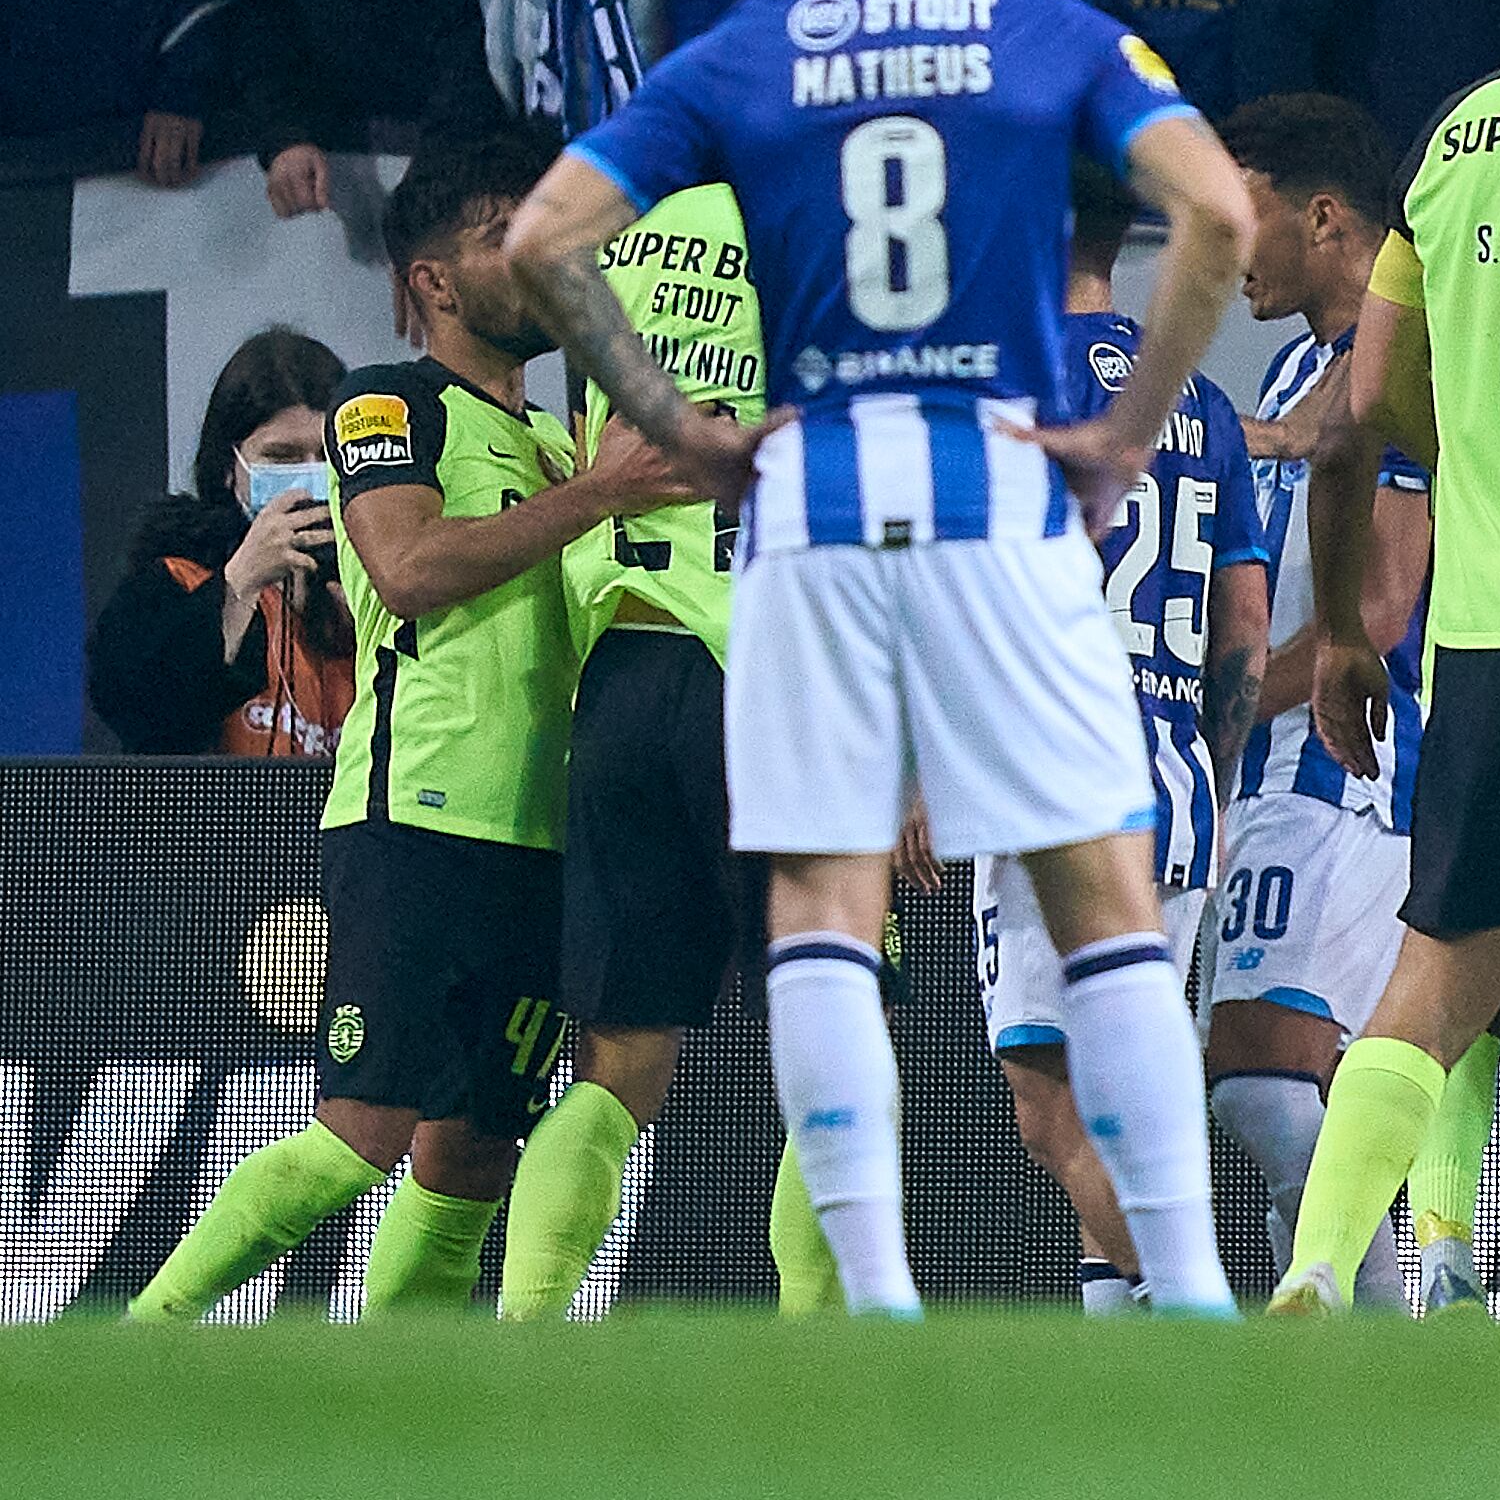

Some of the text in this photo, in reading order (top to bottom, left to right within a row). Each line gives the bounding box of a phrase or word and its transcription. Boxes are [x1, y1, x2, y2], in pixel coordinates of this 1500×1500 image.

[792, 42, 995, 107] MATHEUS
[840, 114, 951, 332] 8
[1476, 224, 1500, 265] S.
[600, 231, 709, 275] SUPER
[651, 281, 744, 327] STOUT
[640, 331, 760, 393] ULINHO
[834, 342, 1000, 384] BINANCE
[342, 414, 392, 437] PORTUGAL
[346, 437, 408, 469] bwin
[1105, 471, 1217, 668] 25
[1221, 865, 1295, 943] 30
[980, 904, 999, 987] 5
